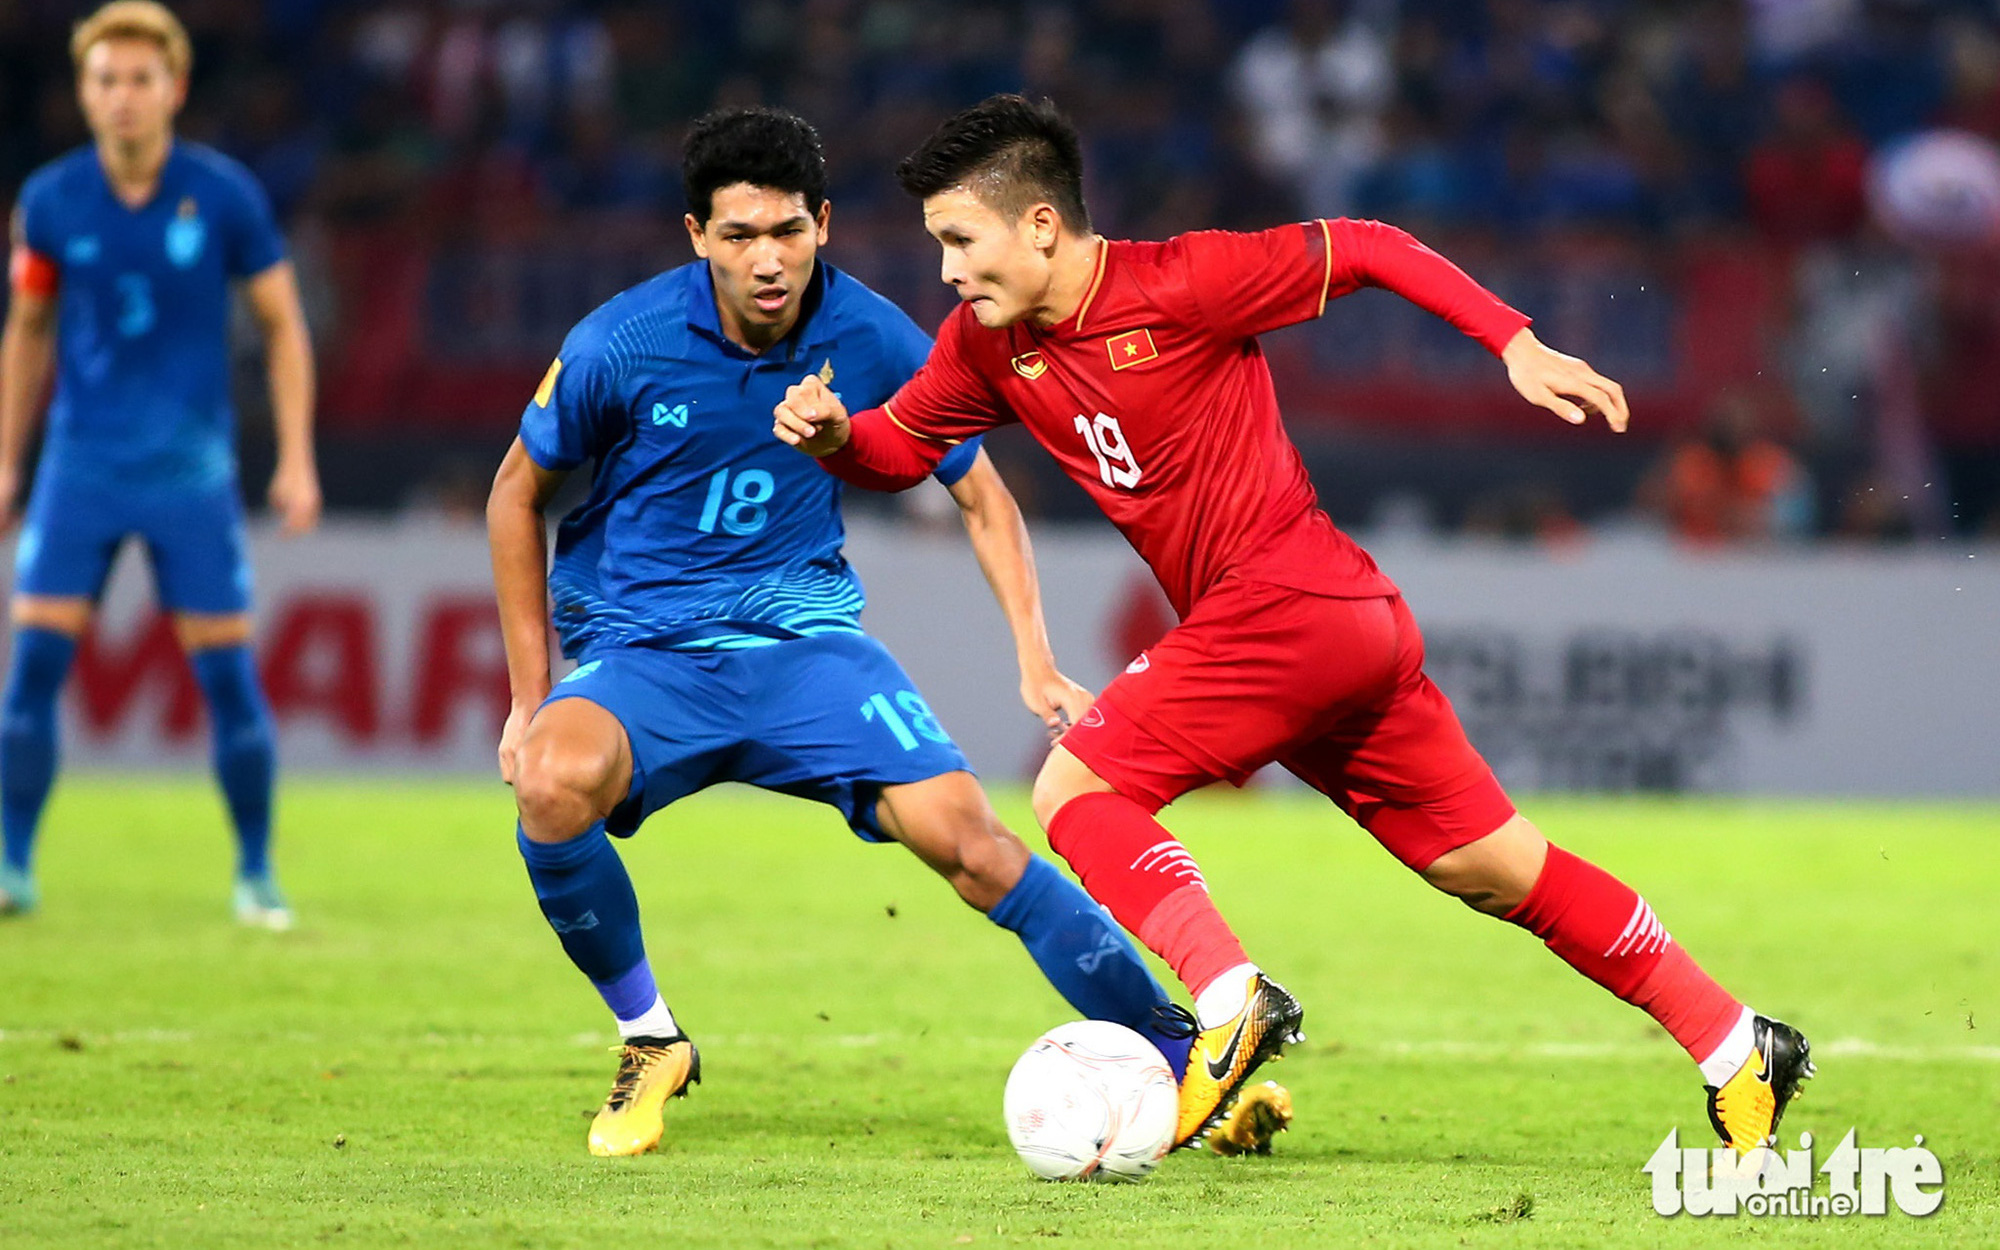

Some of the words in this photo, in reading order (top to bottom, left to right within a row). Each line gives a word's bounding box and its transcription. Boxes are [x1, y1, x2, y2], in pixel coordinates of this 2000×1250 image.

[1073, 412, 1143, 489] 19
[697, 467, 775, 536] 18
[860, 689, 951, 752] 18
